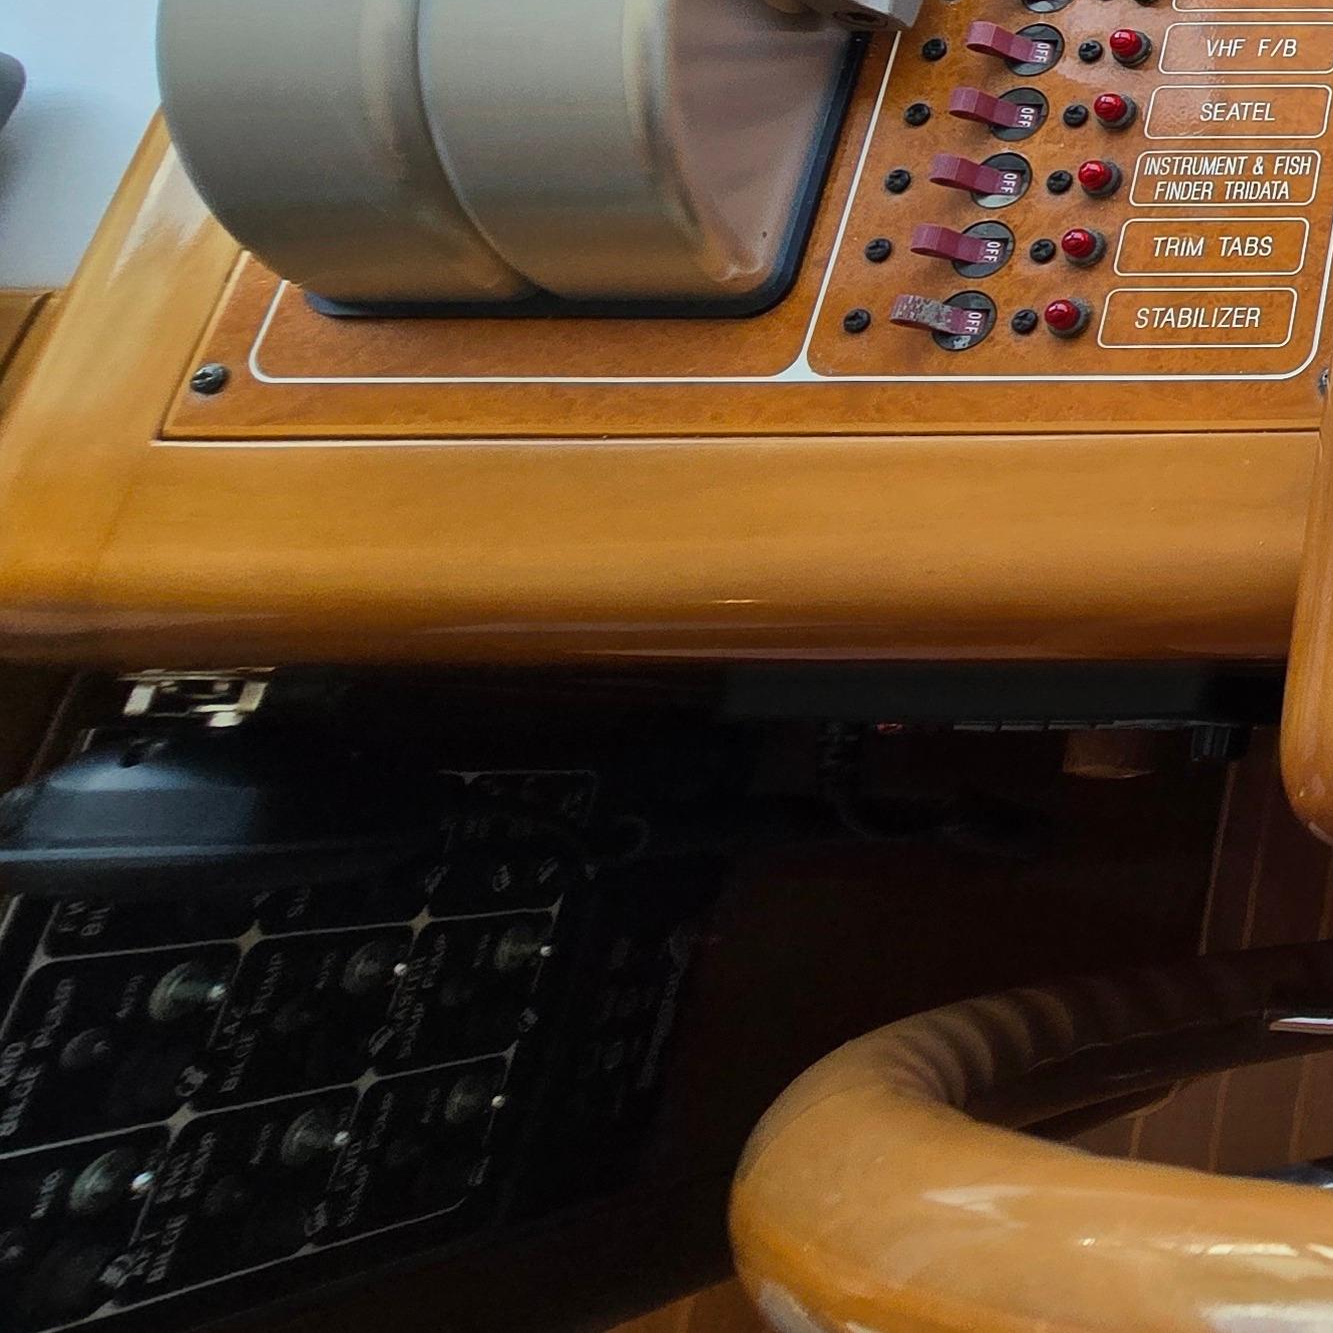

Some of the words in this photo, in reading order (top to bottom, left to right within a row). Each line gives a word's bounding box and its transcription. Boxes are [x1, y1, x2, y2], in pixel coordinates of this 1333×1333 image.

[1035, 42, 1050, 63] OFF
[1206, 38, 1246, 57] VHF
[1258, 39, 1297, 57] F/B
[1018, 107, 1034, 127] OFF
[1200, 102, 1276, 122] SEATEL
[1143, 156, 1246, 176] INSTRUMENT
[1254, 157, 1265, 175] &
[1274, 156, 1311, 176] FISH
[1000, 173, 1017, 194] OFF
[1154, 181, 1213, 201] FINDER
[1224, 181, 1290, 200] TRIDATA
[983, 241, 1001, 263] OFF
[1153, 236, 1204, 258] TRIM
[1219, 235, 1273, 256] TABS
[965, 312, 982, 334] OFF
[1134, 308, 1261, 329] STABILIZER
